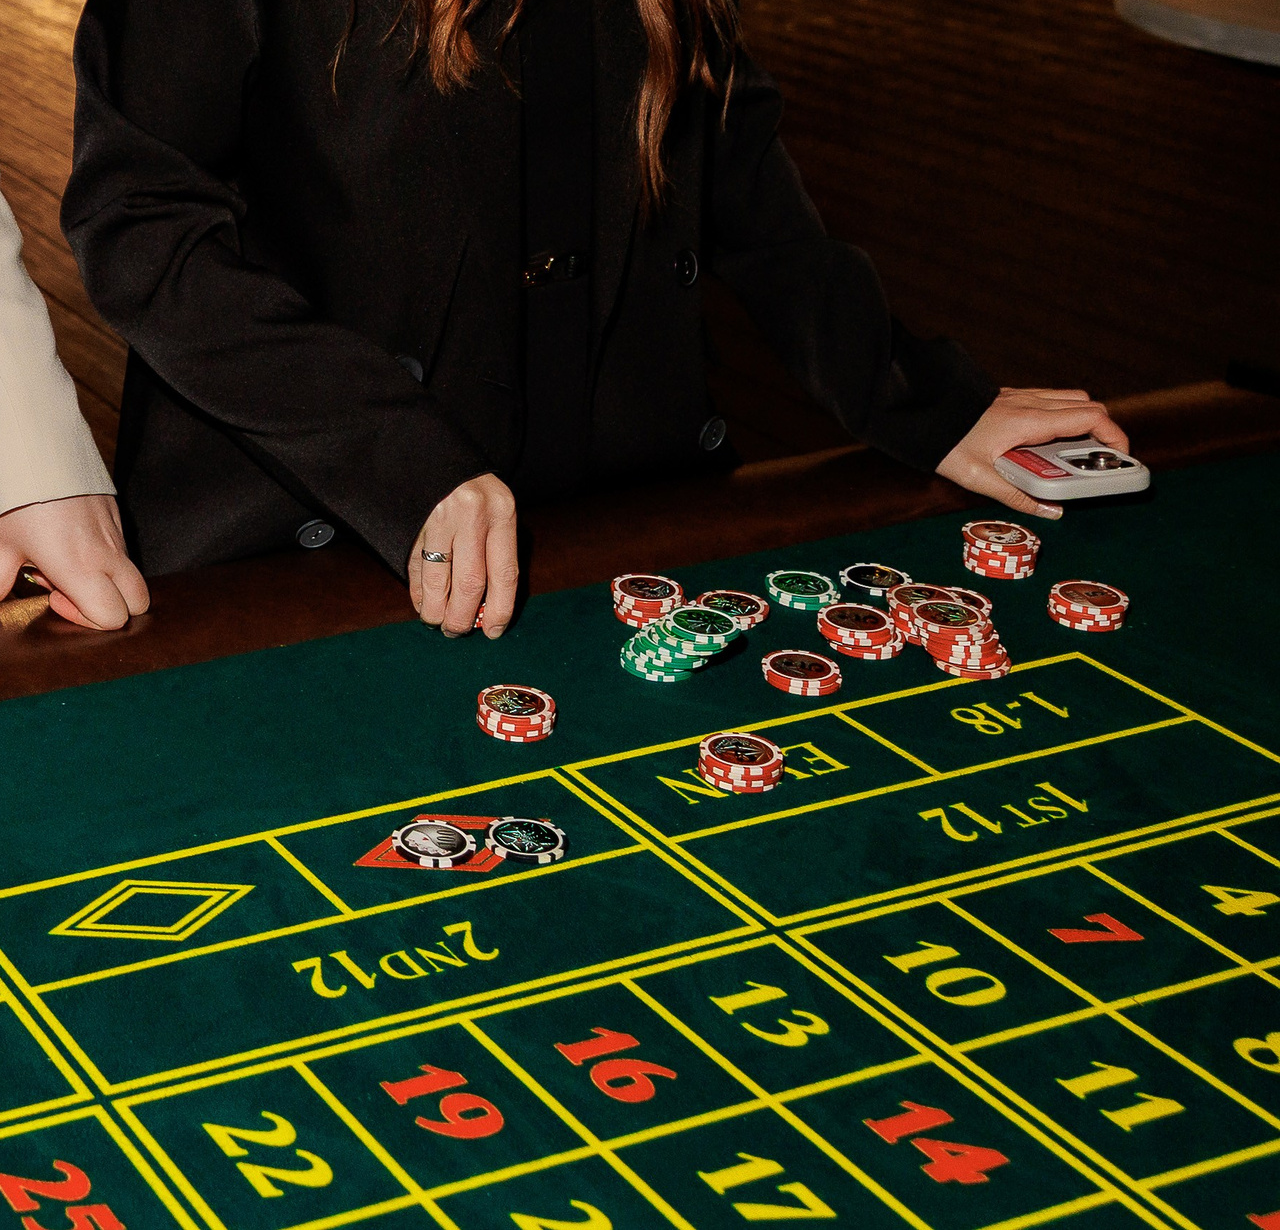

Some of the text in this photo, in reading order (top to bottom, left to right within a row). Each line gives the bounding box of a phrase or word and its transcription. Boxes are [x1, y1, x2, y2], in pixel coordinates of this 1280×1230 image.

[657, 742, 849, 804] EN
[435, 829, 457, 848] 100
[1048, 913, 1144, 943] 7
[1202, 885, 1280, 915] 4
[884, 941, 1006, 1006] 10
[710, 981, 829, 1046] 13
[554, 1027, 677, 1103] 16
[1057, 1062, 1184, 1131] 11
[380, 1064, 504, 1139] 19
[203, 1111, 333, 1197] 22
[863, 1101, 1009, 1184] 14
[698, 1153, 836, 1220] 17
